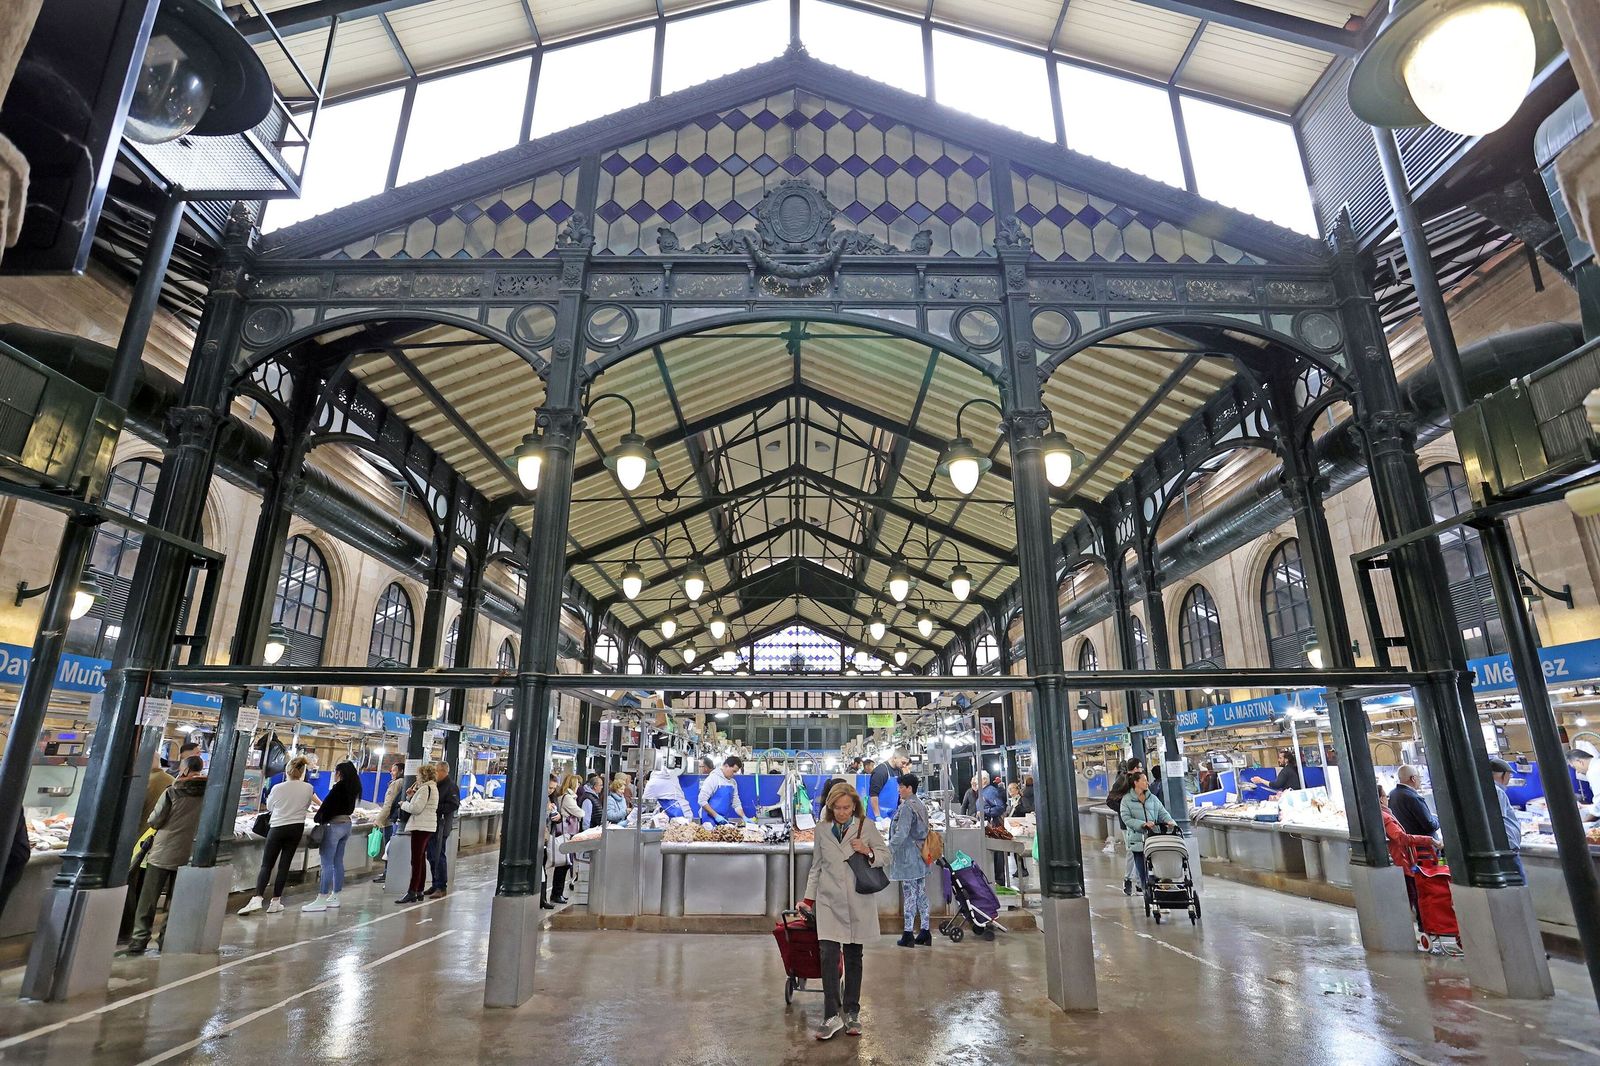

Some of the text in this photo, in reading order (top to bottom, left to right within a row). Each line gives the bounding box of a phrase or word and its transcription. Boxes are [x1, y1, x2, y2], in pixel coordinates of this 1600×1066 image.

[1472, 658, 1569, 687] J.Méez
[280, 693, 298, 717] 15
[319, 702, 357, 724] M.Segura
[1224, 701, 1275, 721] LA MARTINA
[370, 710, 383, 729] 16
[1207, 708, 1215, 726] 5
